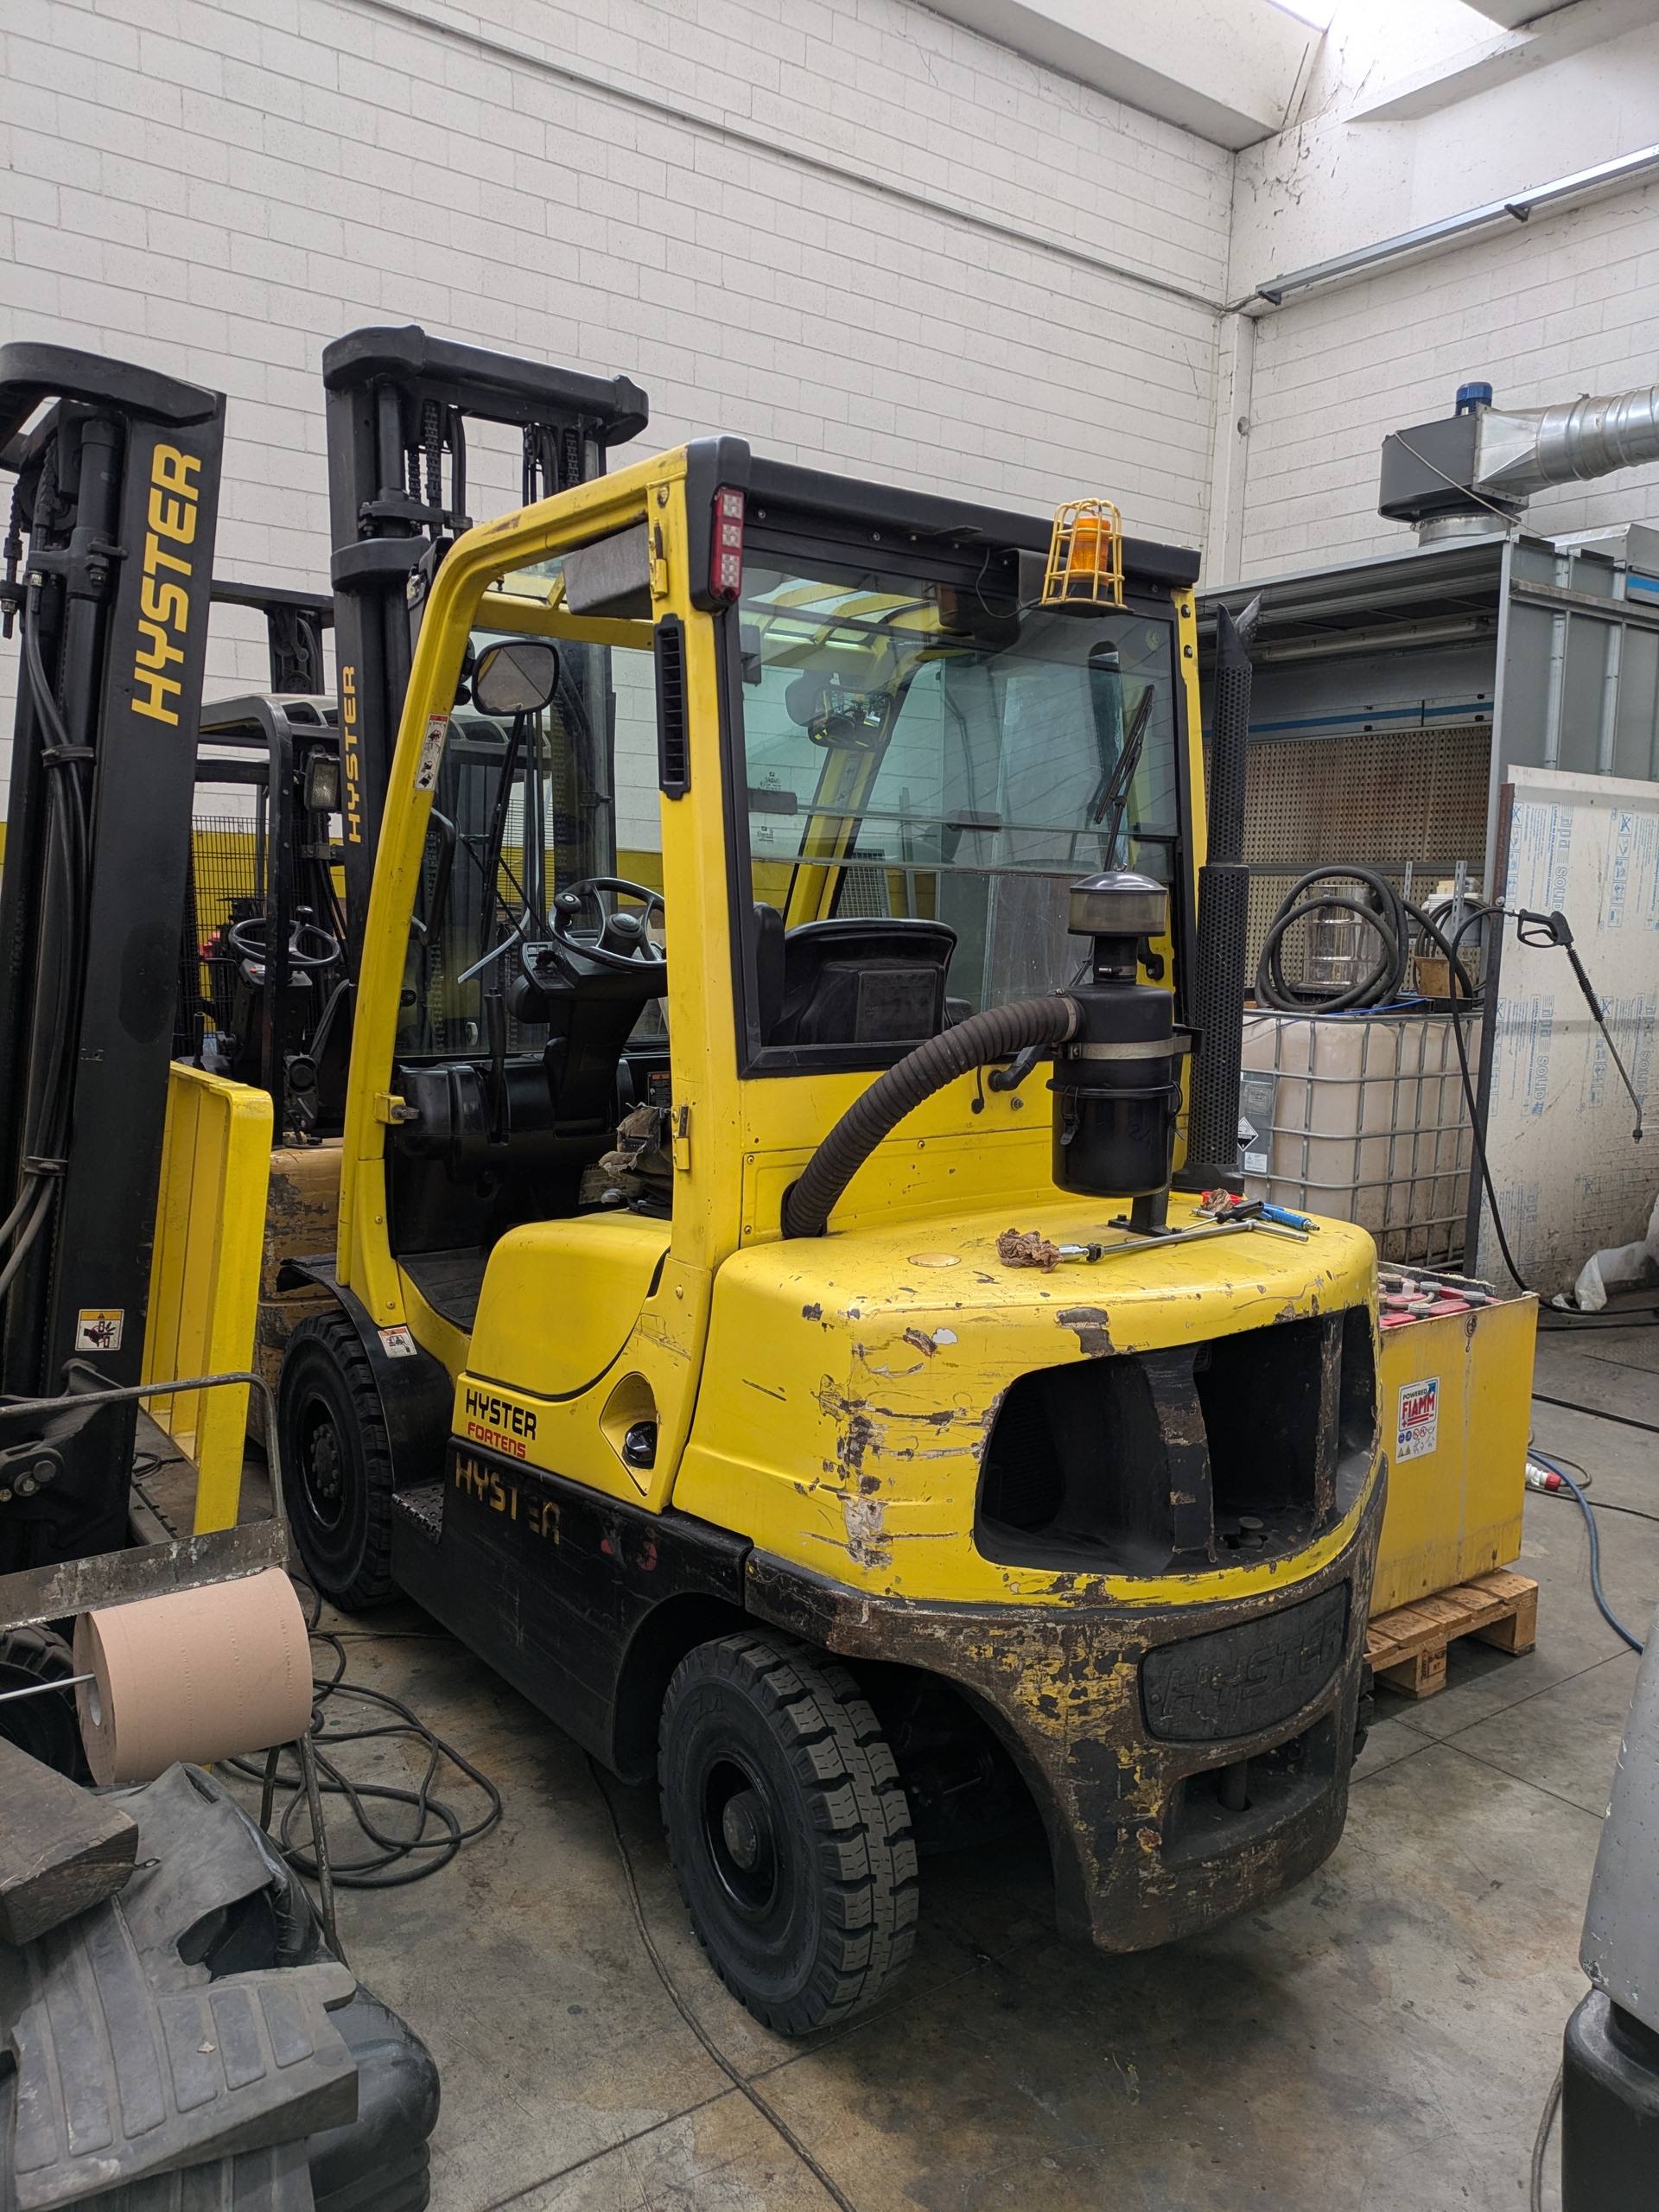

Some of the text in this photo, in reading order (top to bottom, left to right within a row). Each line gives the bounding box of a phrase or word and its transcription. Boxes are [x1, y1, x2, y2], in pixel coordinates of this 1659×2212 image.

[131, 443, 201, 727] HYSTER
[342, 666, 361, 843] HYSTER
[1552, 866, 1567, 912] SOLID
[1535, 1055, 1548, 1101] SOLID
[1637, 1050, 1650, 1092] SOLID
[465, 1388, 537, 1441] HYSTER
[1402, 1388, 1427, 1401] POWERED
[1402, 1393, 1435, 1420] FIAMM
[467, 1421, 526, 1459] FORTENS
